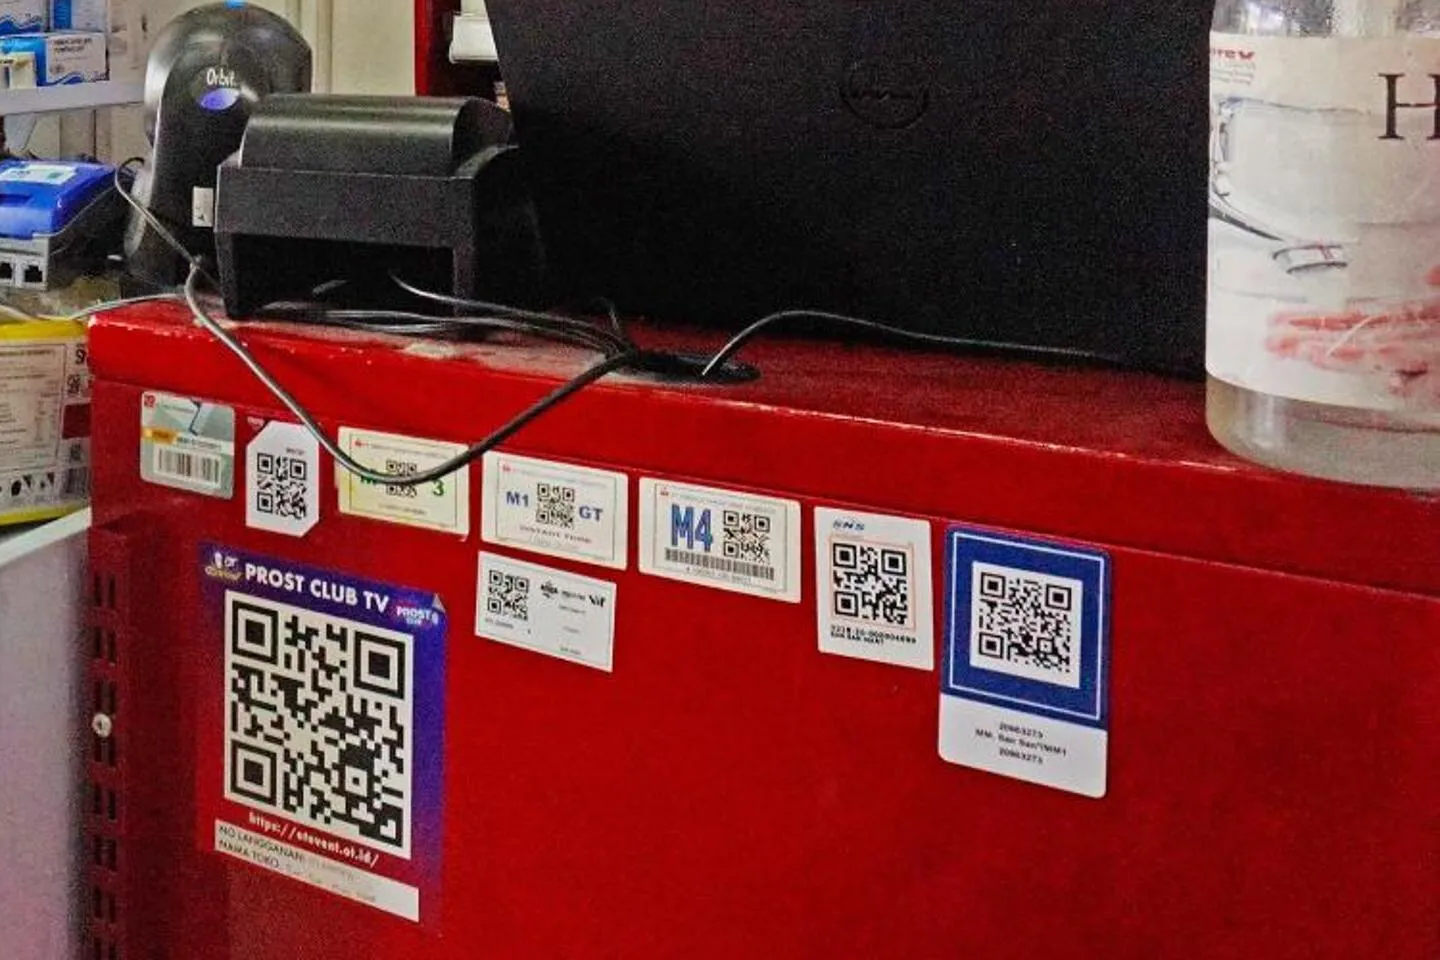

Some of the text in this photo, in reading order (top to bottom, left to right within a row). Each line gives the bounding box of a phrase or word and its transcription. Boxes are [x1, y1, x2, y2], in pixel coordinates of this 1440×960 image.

[506, 491, 604, 522] M1 GT
[671, 503, 714, 553] M4
[244, 563, 306, 593] PROST
[310, 579, 359, 606] CLUB
[363, 591, 390, 613] TV
